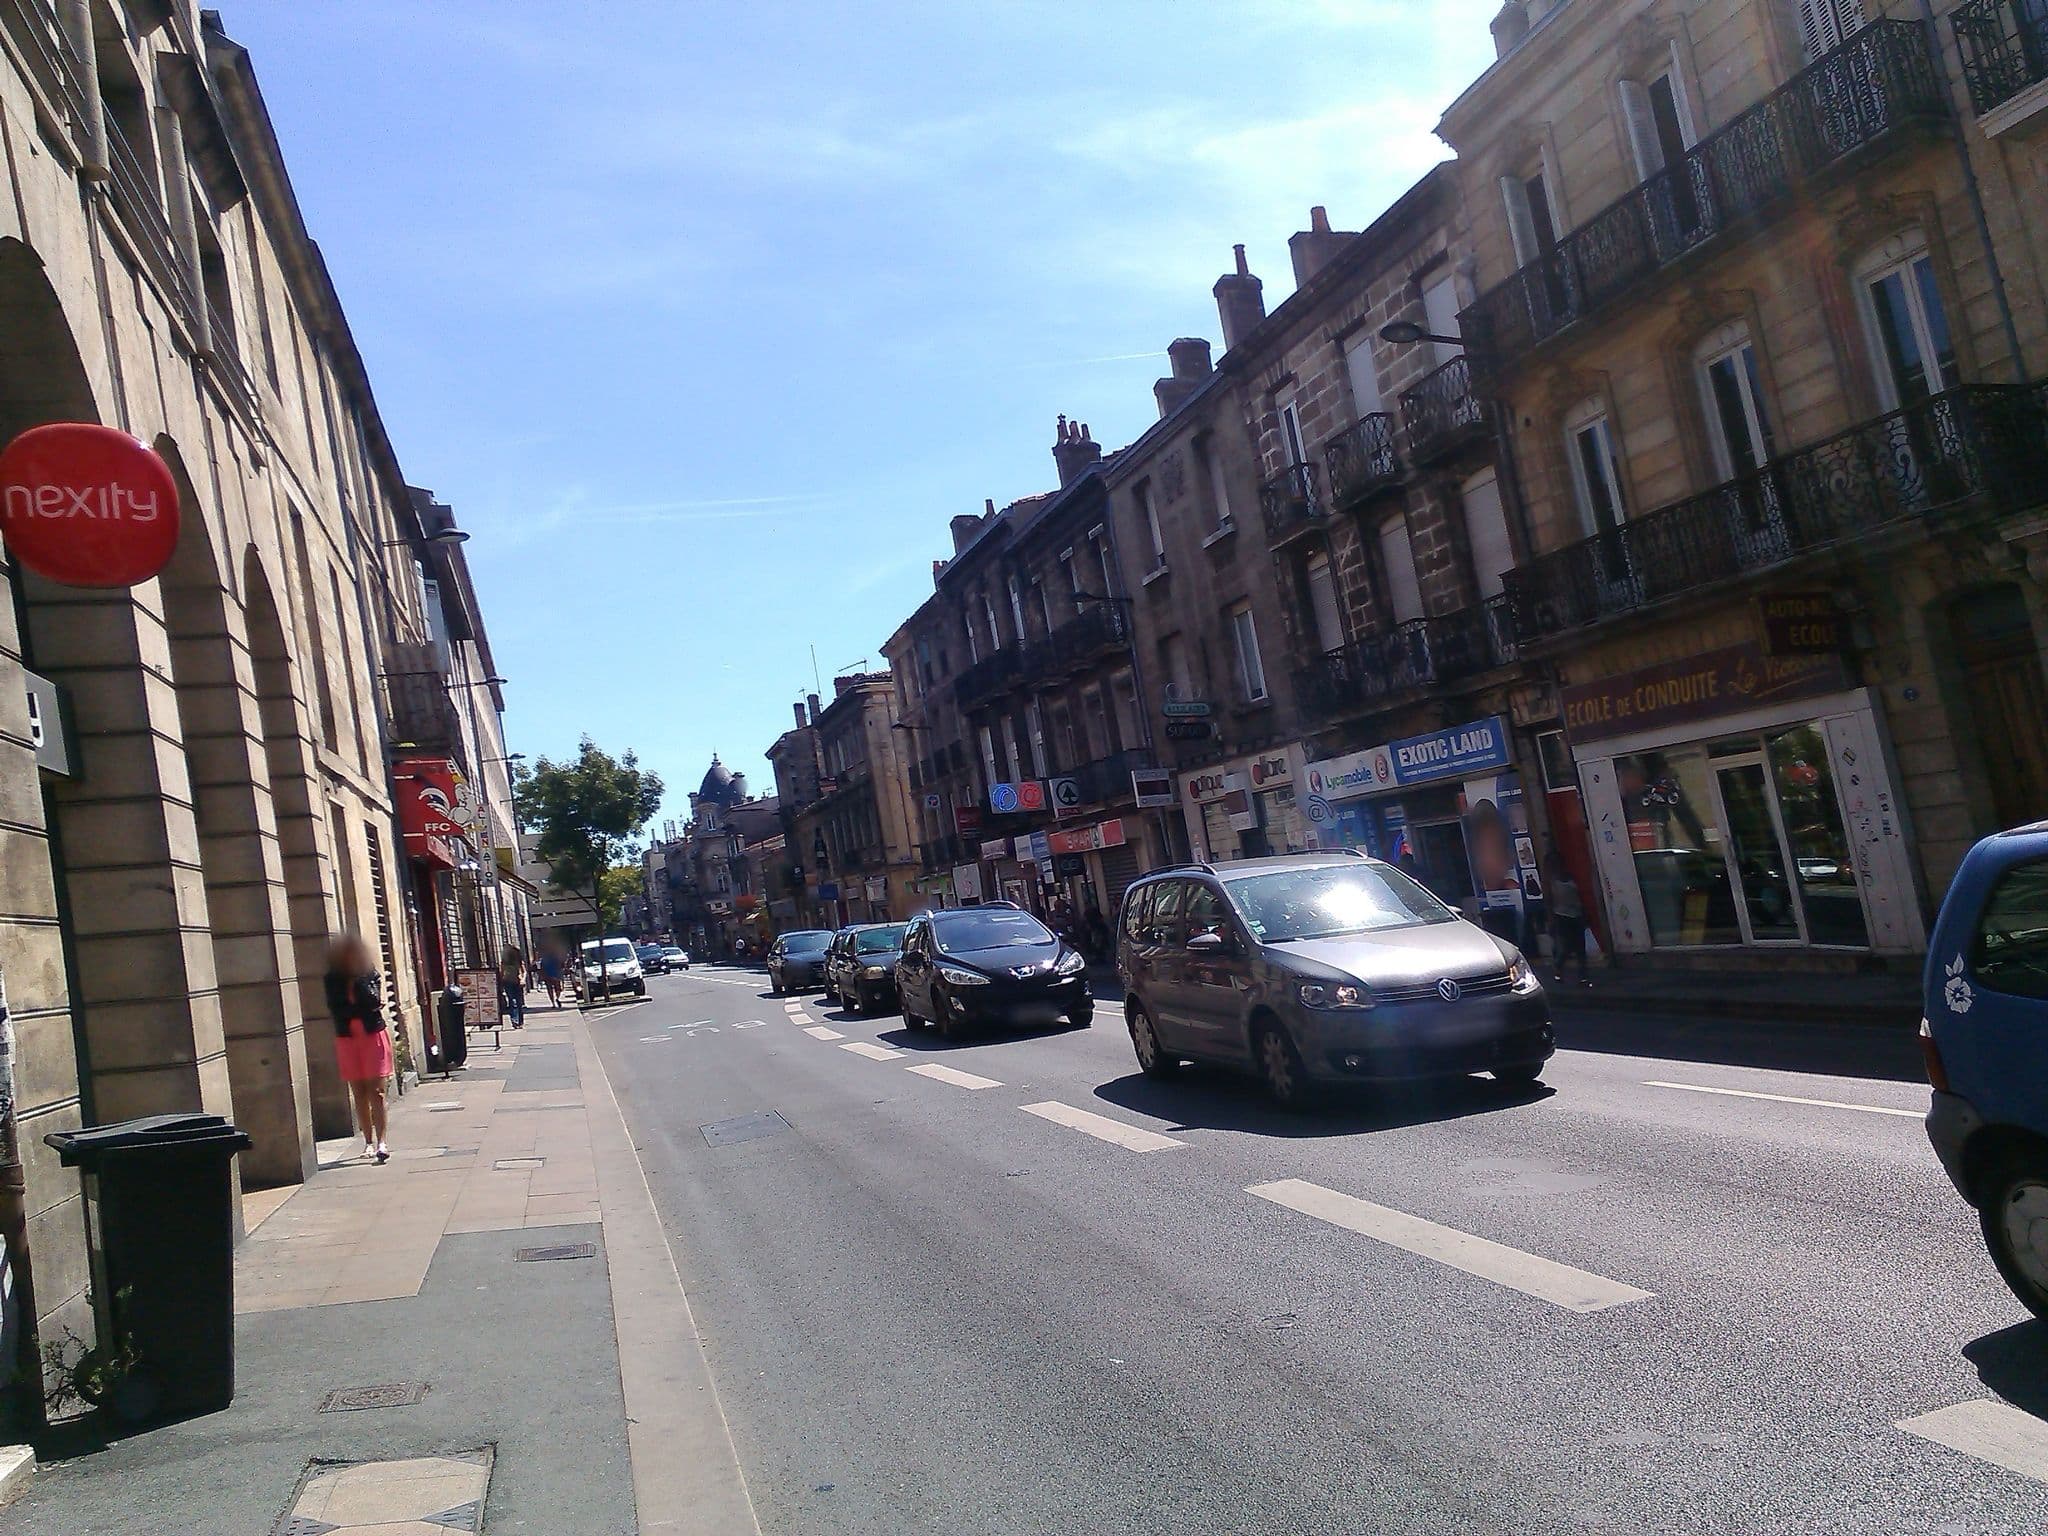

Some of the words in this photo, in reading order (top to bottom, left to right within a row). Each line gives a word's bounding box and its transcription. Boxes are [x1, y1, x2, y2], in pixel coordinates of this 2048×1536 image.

[5, 482, 159, 521] nexity
[1567, 696, 1617, 728] ECOLE
[1634, 671, 1719, 713] CONDUITE
[1397, 739, 1448, 767] EXOTIC
[1450, 728, 1493, 756] LAND
[1325, 767, 1372, 790] Lycamobile
[424, 822, 451, 832] FFC
